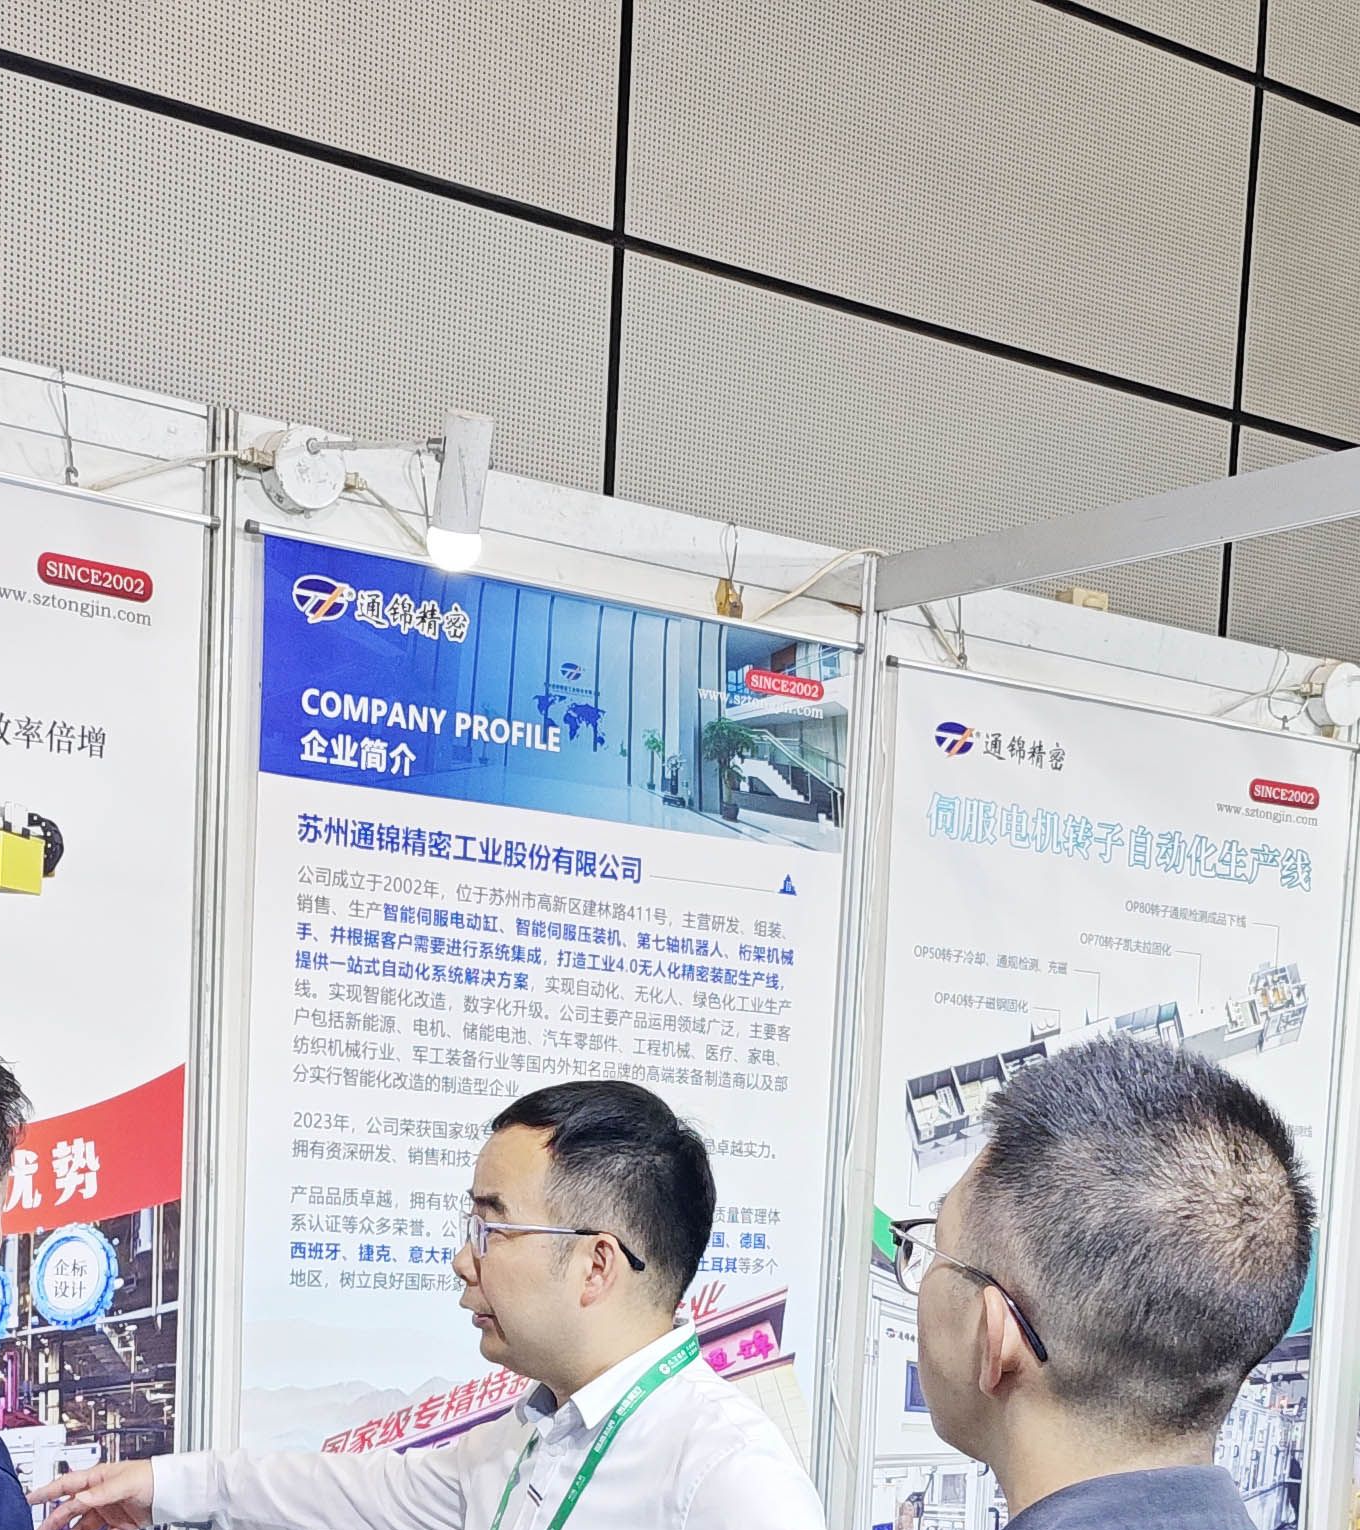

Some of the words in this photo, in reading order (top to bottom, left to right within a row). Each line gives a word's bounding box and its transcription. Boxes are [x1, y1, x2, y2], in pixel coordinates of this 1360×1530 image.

[45, 560, 146, 596] SINCE2002
[357, 593, 468, 640] 通锦精密
[750, 675, 819, 698] SINCE2002
[301, 688, 447, 735] COMPANY
[455, 712, 561, 752] PROFILE
[300, 730, 416, 776] 企业简介
[983, 733, 1066, 771] 通锦精密
[1253, 784, 1315, 805] SINCE2002
[1216, 801, 1318, 827] www.sztongjin.com
[296, 814, 643, 885] 苏州通锦精密工业股份有限公司
[927, 792, 1312, 893] 伺服电机转子自动化生产线
[54, 1280, 86, 1299] 设计
